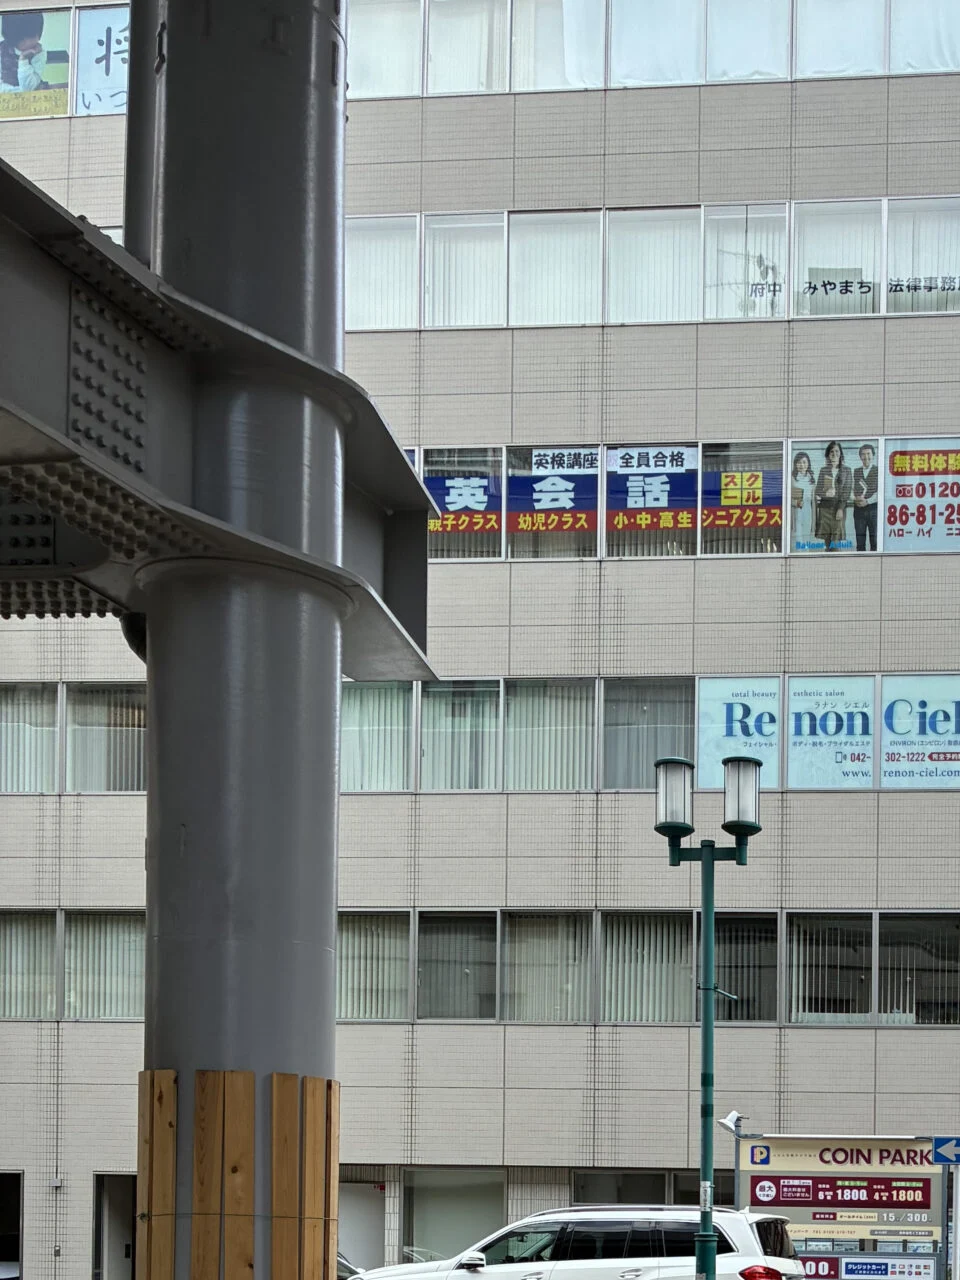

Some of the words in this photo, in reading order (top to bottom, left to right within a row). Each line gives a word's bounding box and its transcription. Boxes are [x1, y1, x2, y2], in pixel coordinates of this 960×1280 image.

[750, 281, 783, 298] 府中
[803, 280, 872, 295] みやまち
[533, 452, 599, 470] 英検講座
[618, 450, 686, 469] 全員合格
[915, 481, 960, 498] 0120
[518, 513, 588, 531] 幼児クラス
[701, 508, 782, 528] シニアクラス
[888, 527, 913, 537] ハロー
[917, 527, 933, 537] ハイ
[731, 690, 750, 698] total
[752, 690, 777, 699] beauty
[793, 689, 825, 697] esthetic
[825, 689, 845, 697] salon
[814, 701, 838, 709] ラナン
[844, 701, 870, 709] シエル
[885, 752, 926, 762] 302-1222
[842, 770, 872, 778] www.
[819, 1148, 873, 1165] COIN
[879, 1149, 934, 1165] PARK
